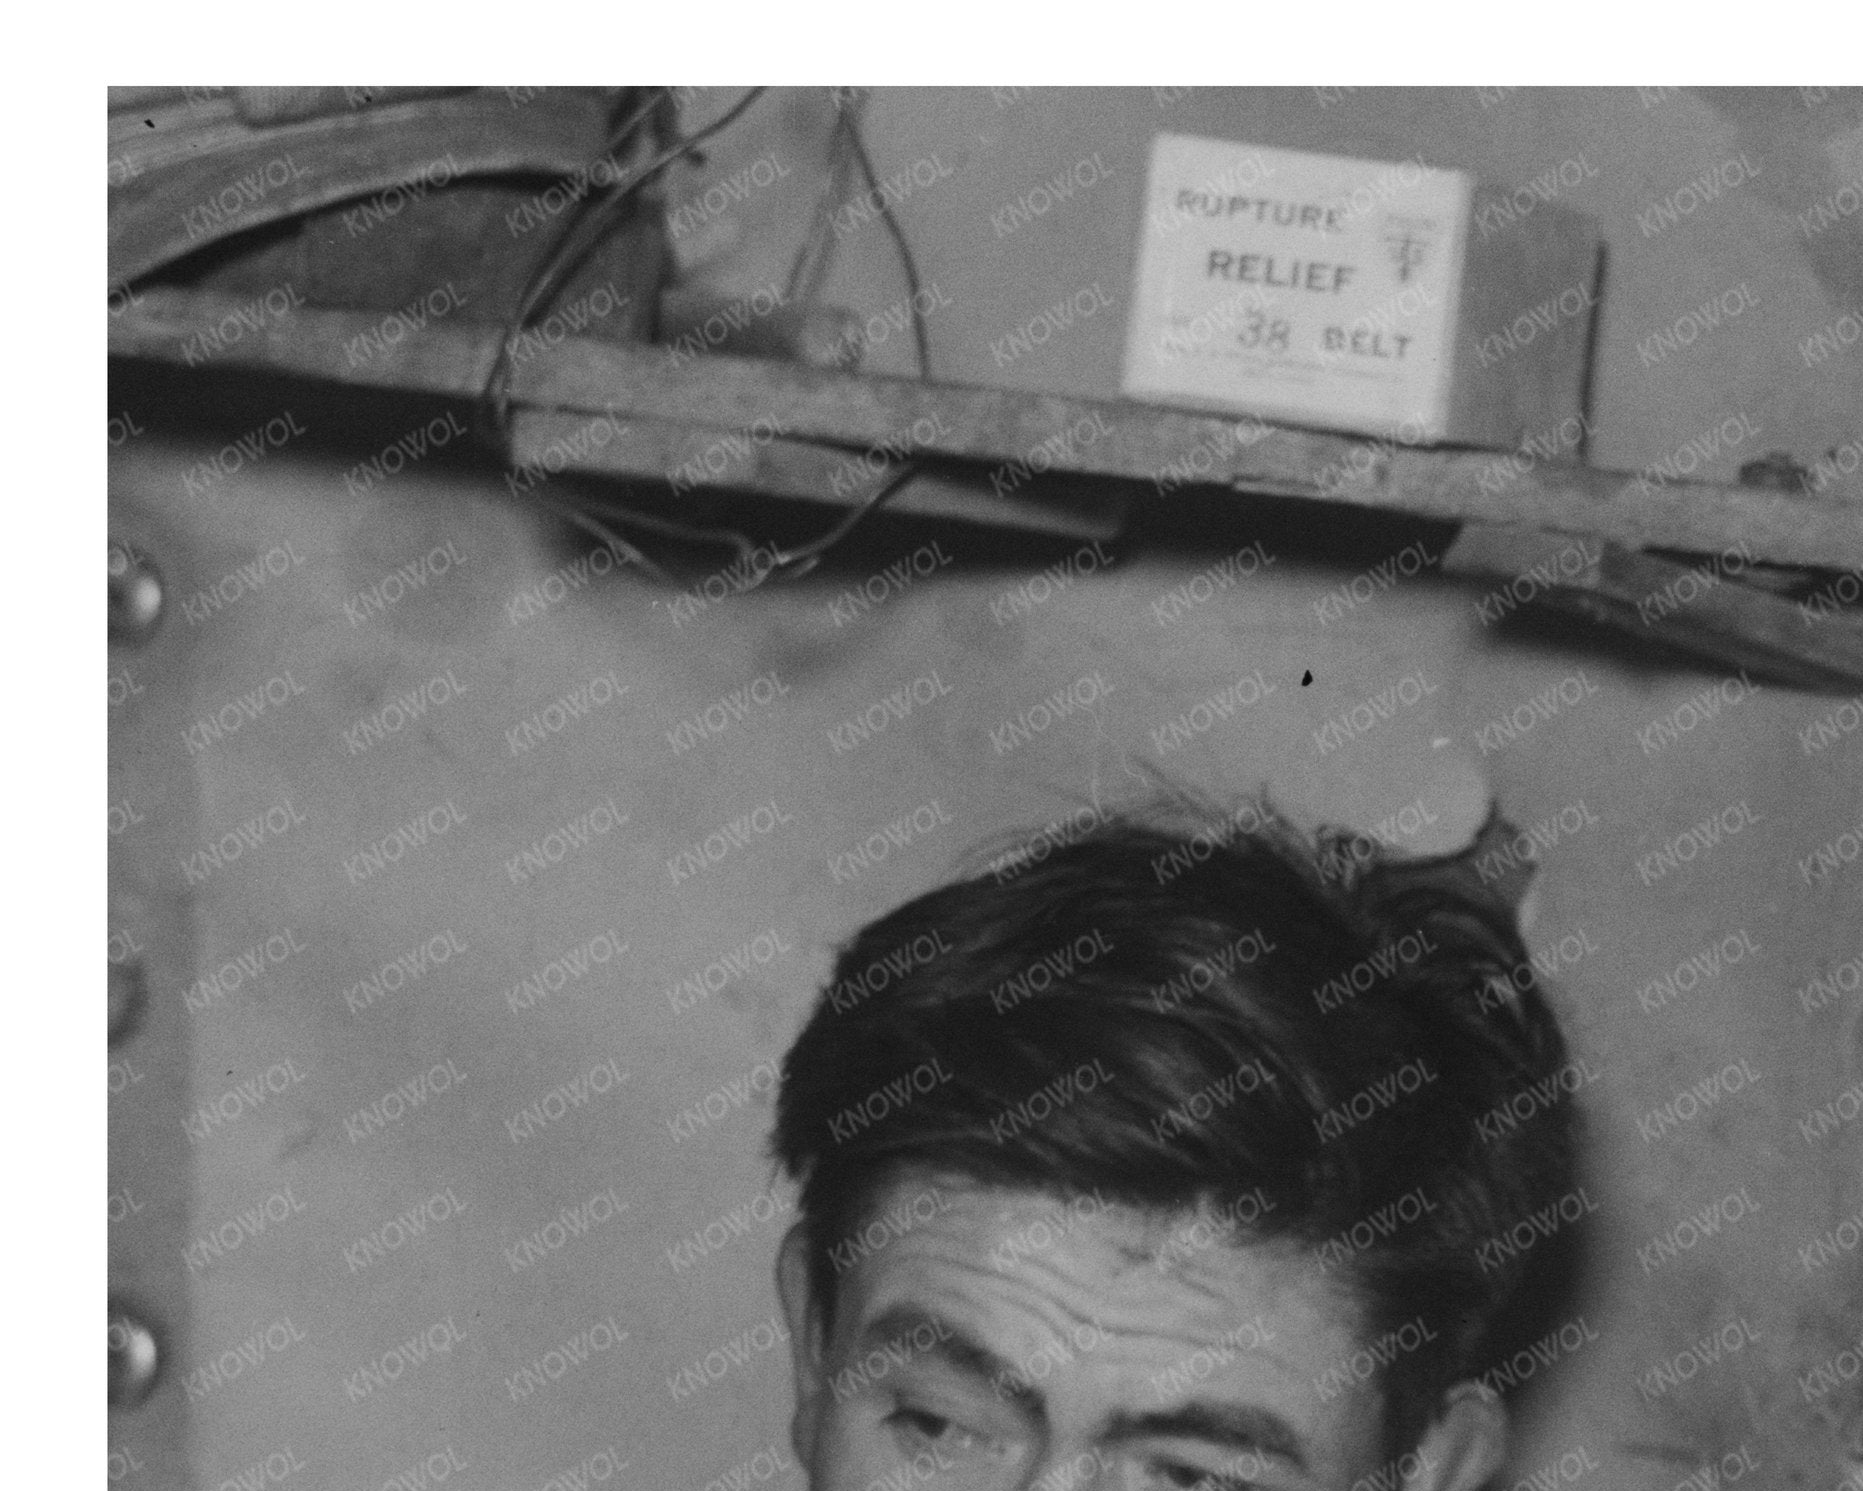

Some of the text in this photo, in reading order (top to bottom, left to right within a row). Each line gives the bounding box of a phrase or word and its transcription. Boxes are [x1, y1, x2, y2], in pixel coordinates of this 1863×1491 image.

[1176, 189, 1345, 233] RUPTURE
[1206, 249, 1357, 294] RELIEF
[1236, 309, 1291, 353] 38
[1321, 326, 1412, 360] BELT
